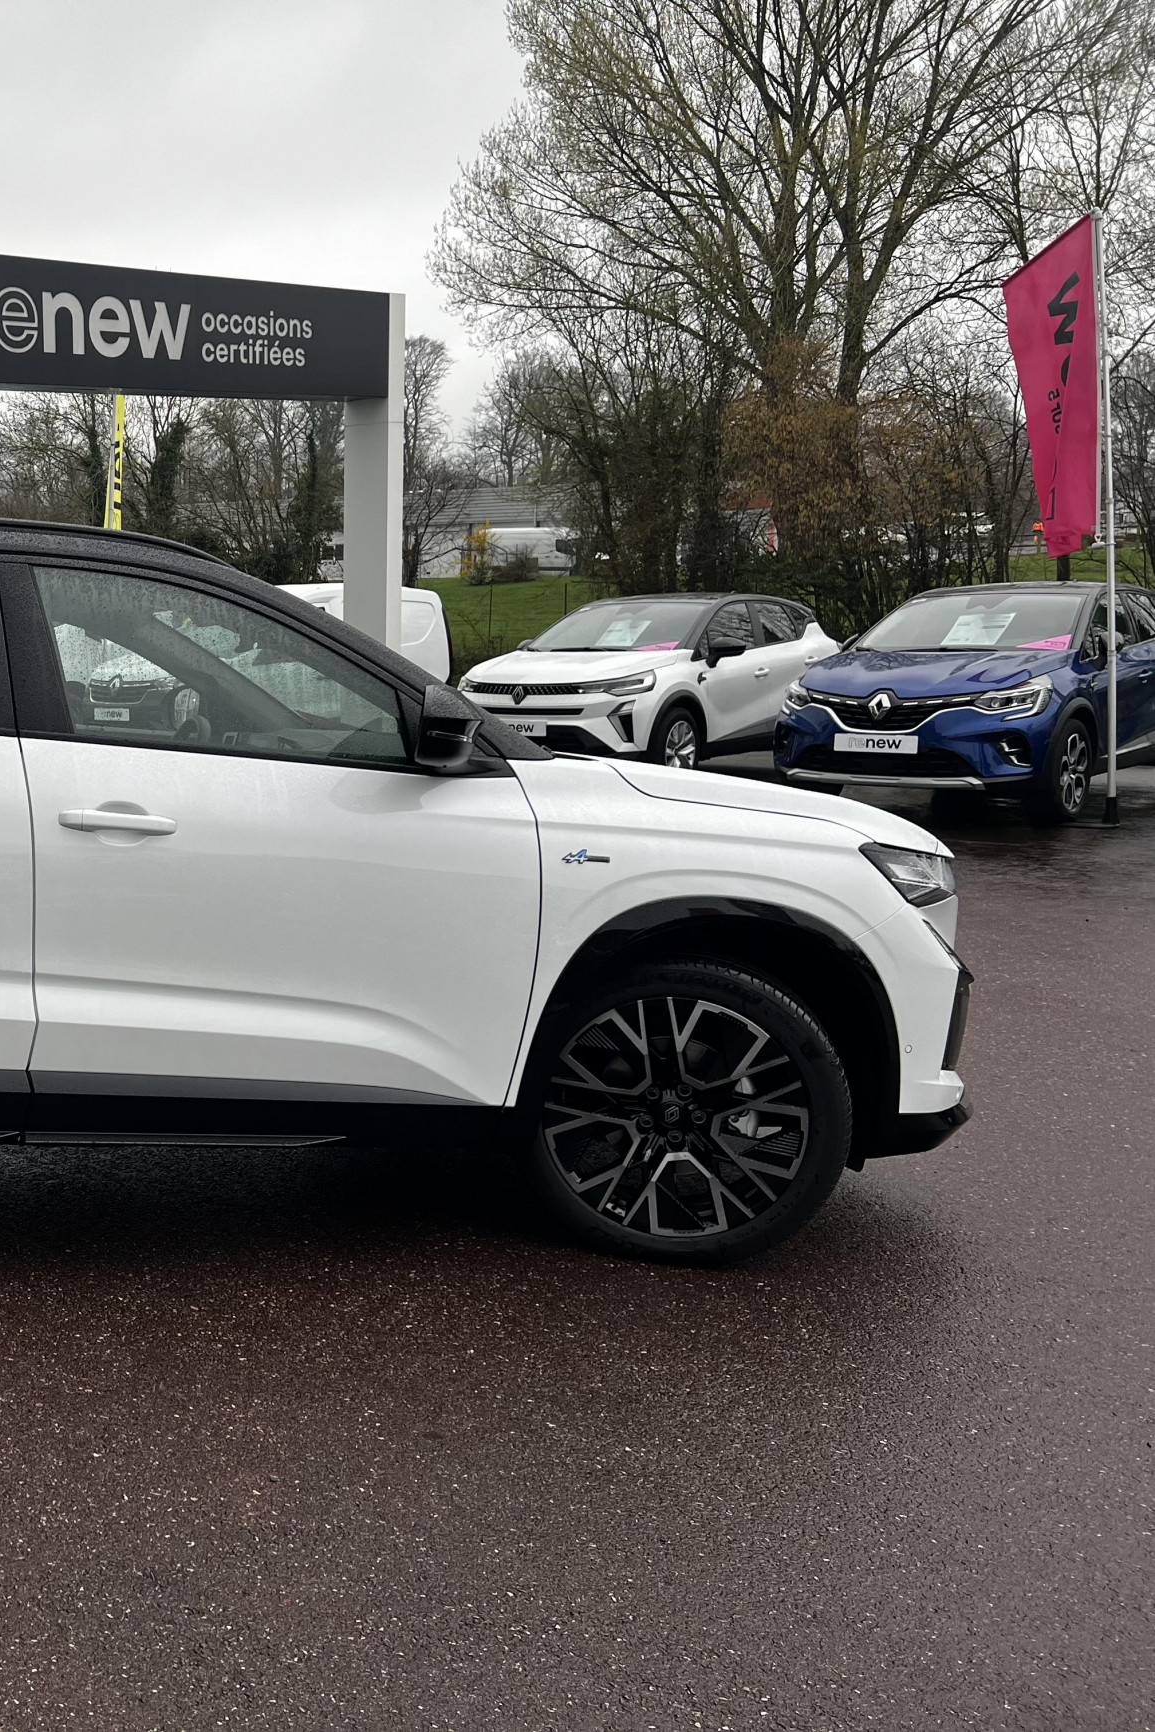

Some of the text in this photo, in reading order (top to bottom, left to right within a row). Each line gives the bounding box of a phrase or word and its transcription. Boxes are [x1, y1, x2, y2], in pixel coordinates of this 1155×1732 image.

[201, 310, 313, 339] occasions
[201, 339, 306, 367] certifiées
[848, 737, 902, 749] renew
